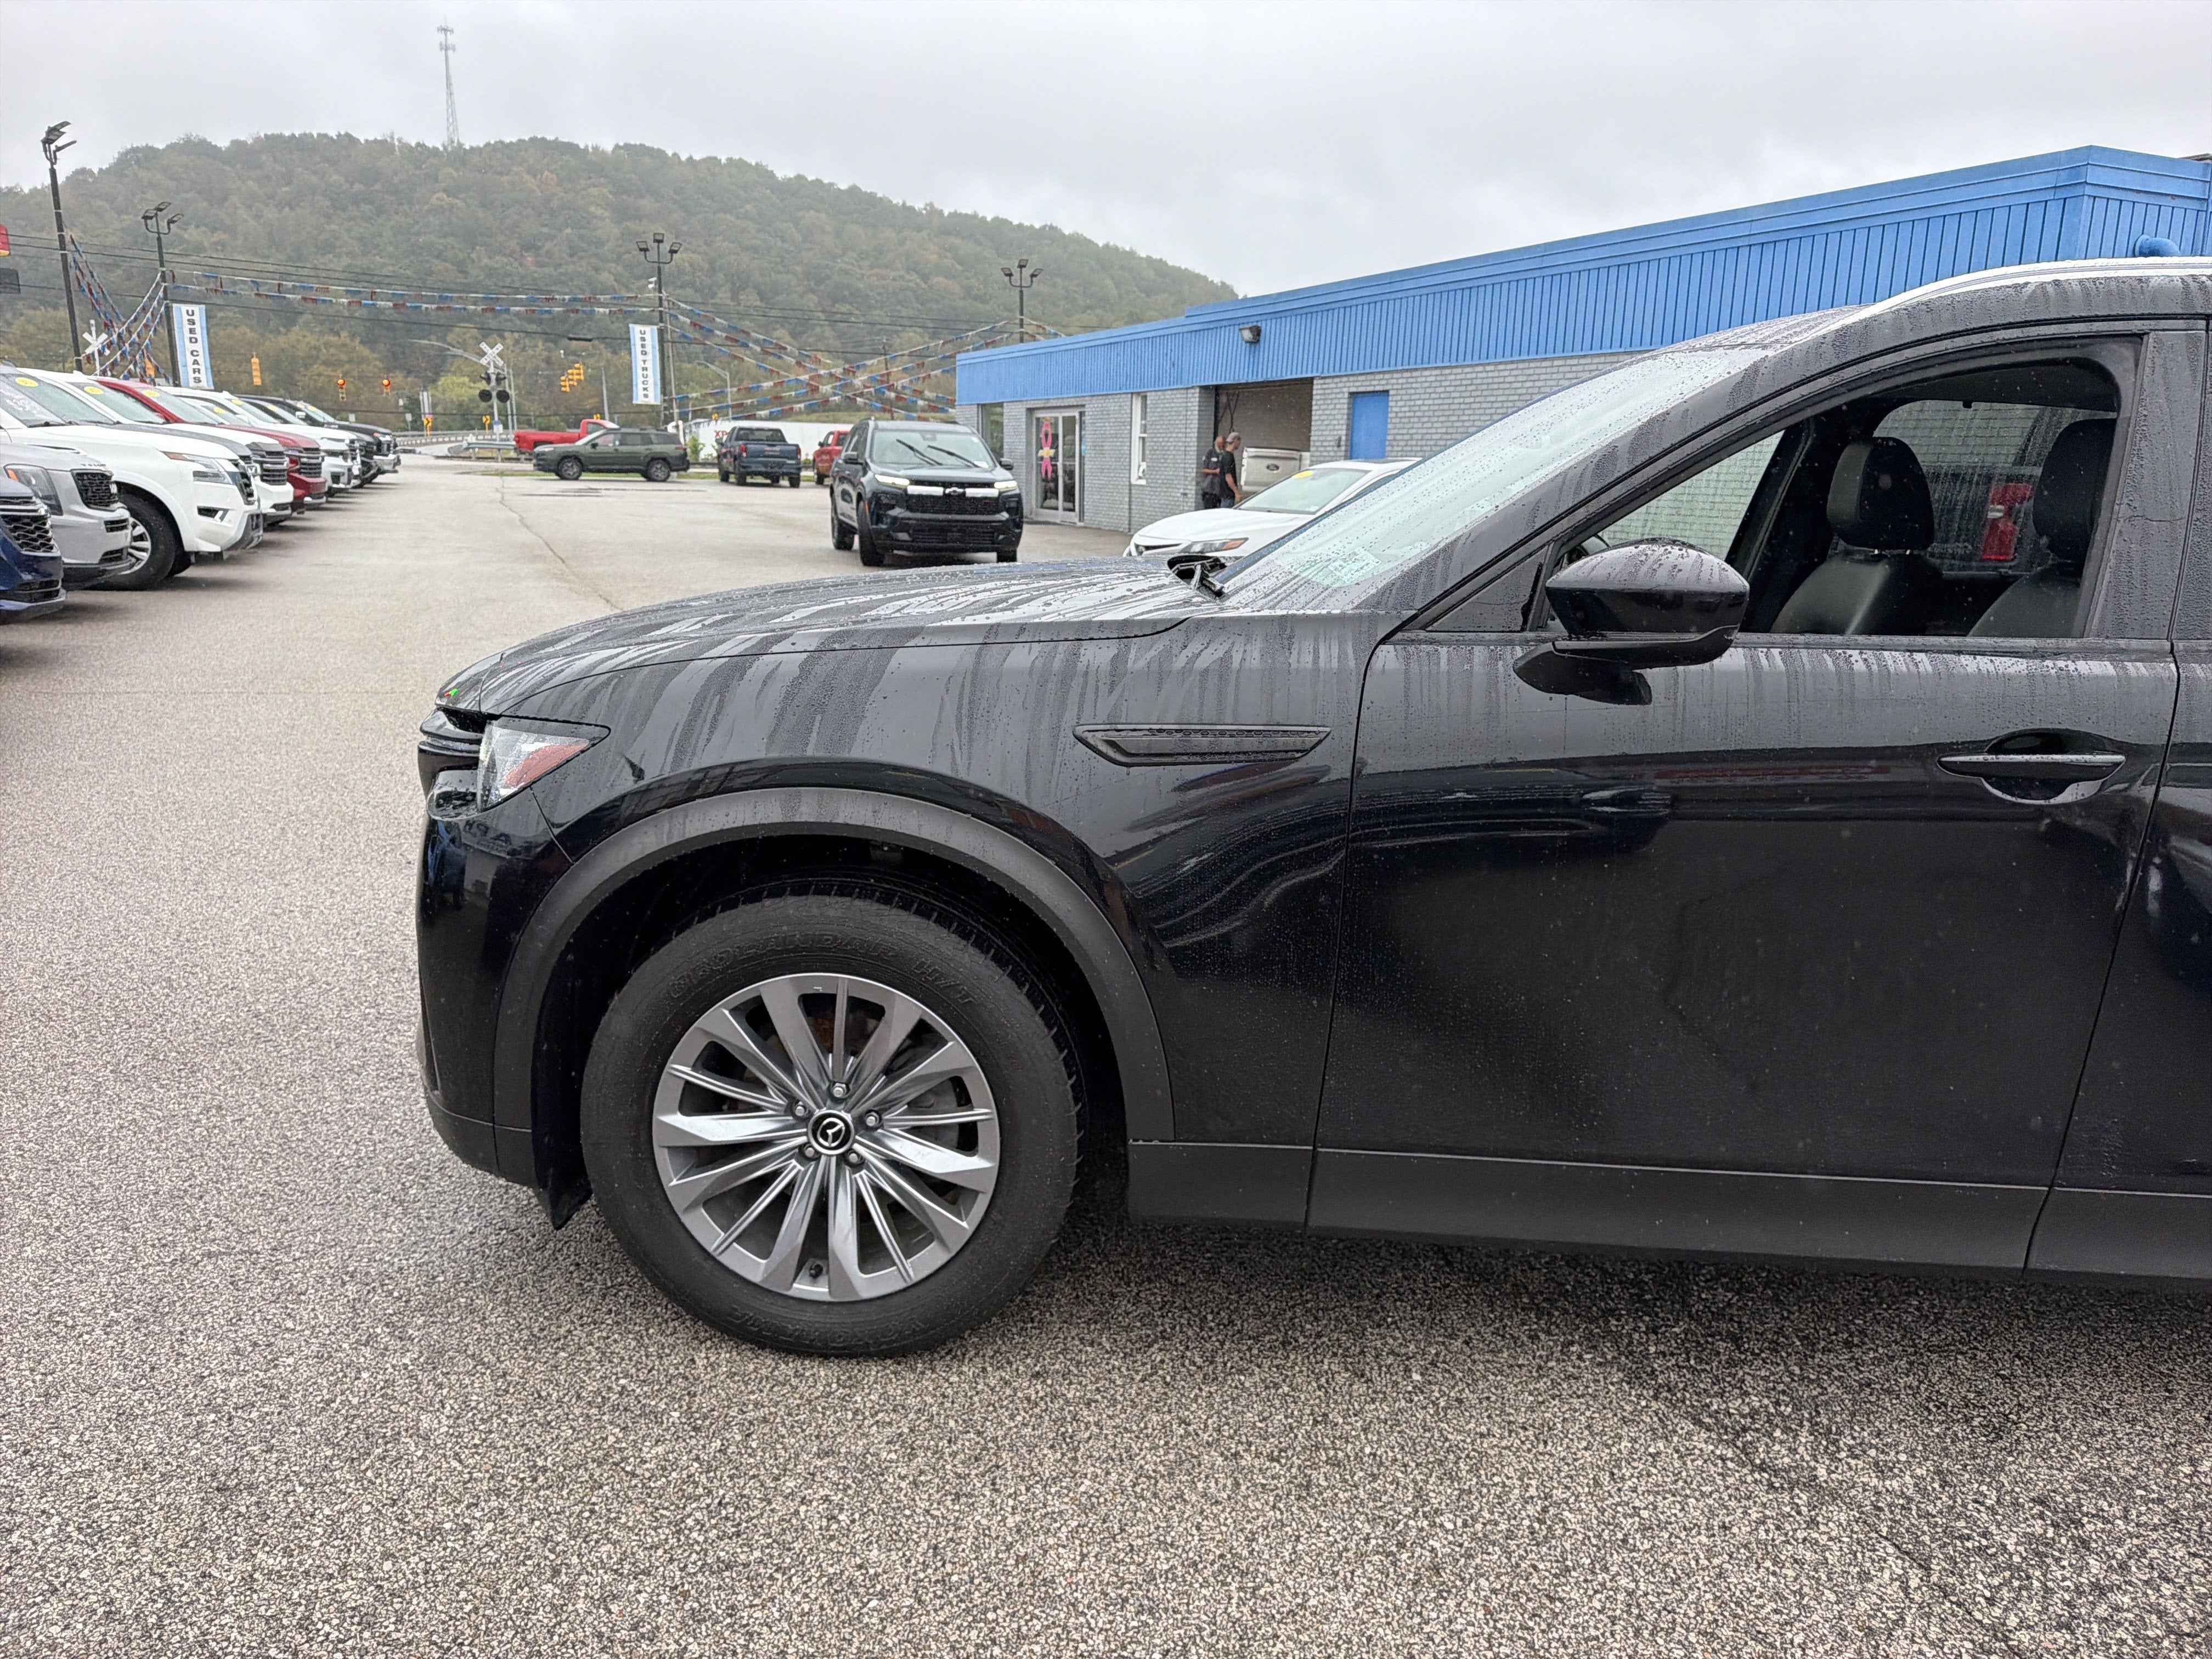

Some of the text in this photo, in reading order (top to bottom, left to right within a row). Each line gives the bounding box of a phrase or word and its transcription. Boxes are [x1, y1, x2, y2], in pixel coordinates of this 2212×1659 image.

[186, 309, 202, 383] USED CARS
[639, 329, 649, 399] USED TRUCKS
[713, 430, 729, 438] XP
